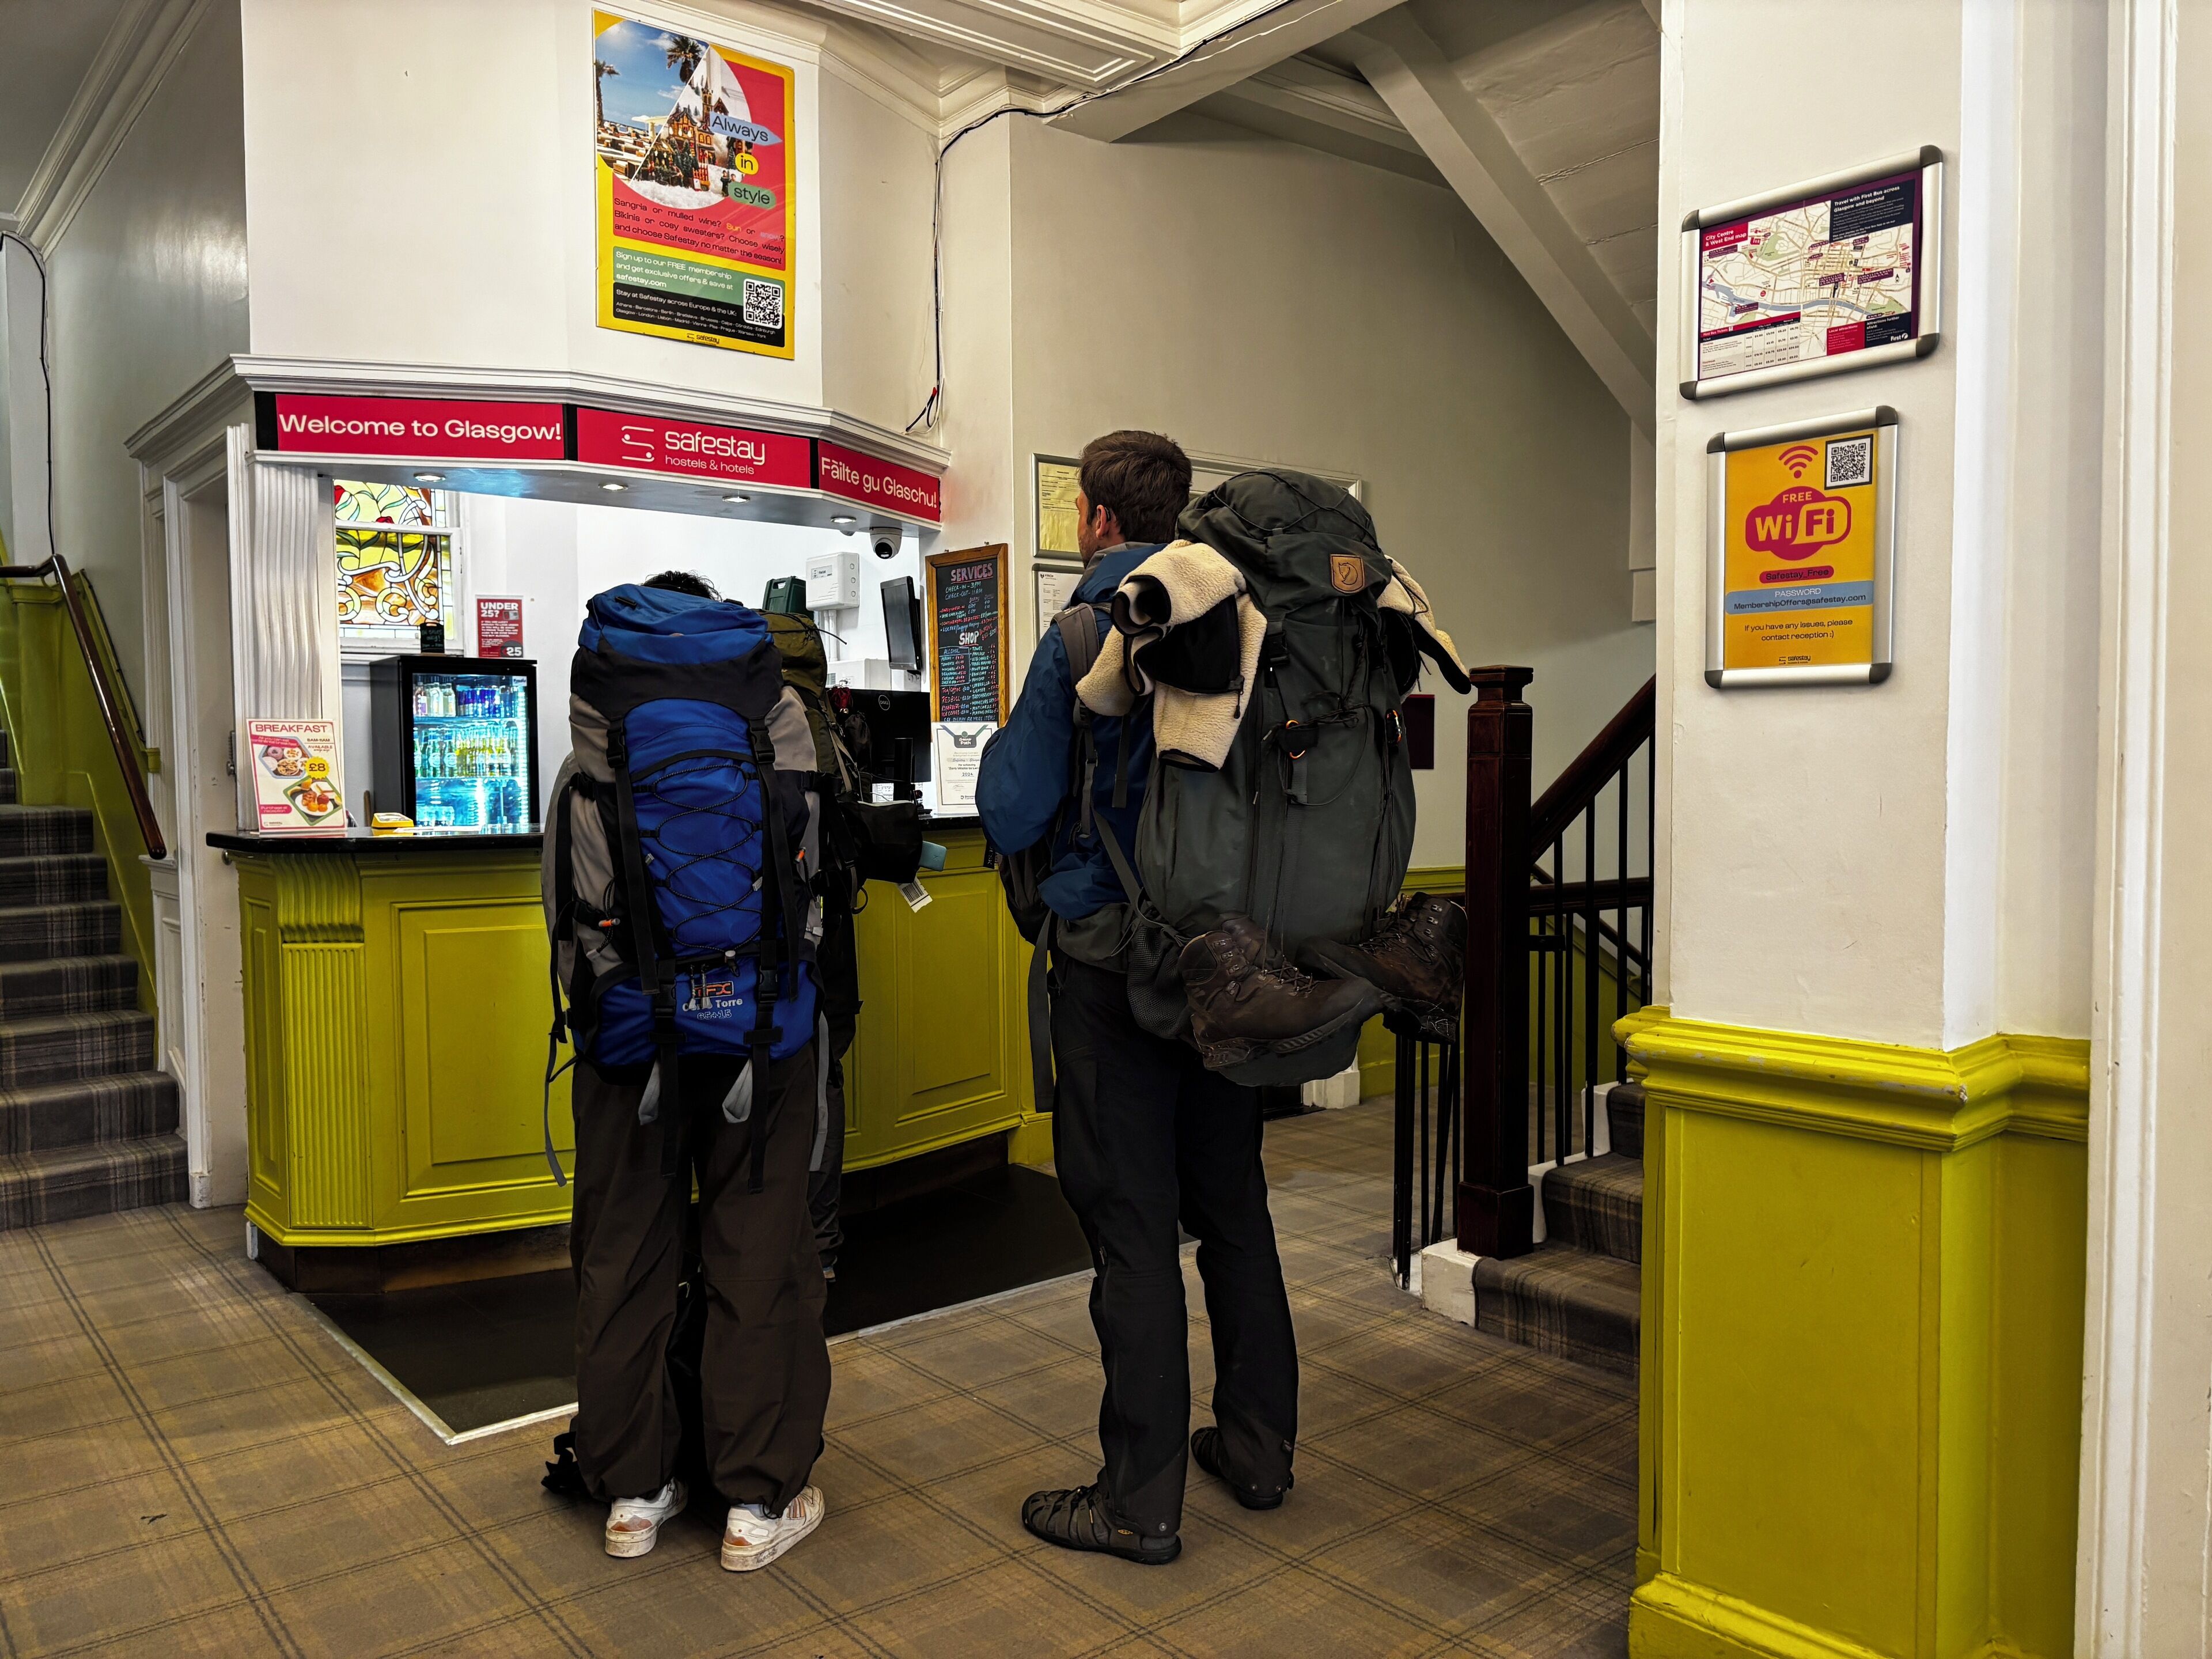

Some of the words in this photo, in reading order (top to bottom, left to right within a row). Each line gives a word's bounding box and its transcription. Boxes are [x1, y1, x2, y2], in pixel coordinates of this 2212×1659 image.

[712, 115, 768, 142] Always
[741, 156, 753, 171] in
[734, 187, 770, 204] style
[614, 198, 647, 211] Sangria
[668, 211, 694, 221] mulled
[699, 218, 721, 227] wine?
[1834, 204, 1854, 213] Glasgow
[1866, 196, 1884, 204] beyond
[615, 210, 640, 221] Bikinis
[659, 221, 679, 230] cosy
[683, 226, 725, 240] sweaters?
[729, 235, 758, 247] Choose
[762, 244, 785, 254] wisely
[615, 224, 630, 232] and
[632, 227, 662, 238] choose
[664, 233, 699, 247] Safestay
[713, 245, 738, 253] matter
[753, 254, 782, 264] season!
[616, 251, 632, 260] Sign
[668, 261, 686, 270] FREE
[688, 266, 732, 280] membership
[616, 274, 666, 287] safestay.com
[645, 268, 678, 279] exclusive
[679, 275, 702, 284] offers
[616, 289, 631, 298] Stay
[639, 293, 666, 304] Safestay
[689, 302, 711, 312] Europe
[696, 335, 719, 344] safestay
[279, 414, 405, 435] Welcome
[411, 419, 438, 437] to
[445, 419, 562, 444] Glasgow!
[665, 431, 765, 465] safestay
[665, 455, 707, 469] hostels
[710, 460, 718, 471] &
[721, 461, 755, 475] hotels
[862, 474, 880, 493] gu
[883, 476, 937, 508] Glaschu!
[1783, 491, 1812, 503] FREE
[951, 563, 993, 582] SERVICES
[1766, 568, 1829, 581] Safestay_Free
[1775, 588, 1821, 597] PASSWORD
[480, 602, 518, 610] UNDER
[1734, 594, 1866, 610] MembershipOffers@safestay.com
[959, 631, 979, 645] SHOP
[1791, 631, 1828, 640] reception
[507, 647, 522, 656] 25
[256, 724, 327, 733] BREAKFAST
[309, 763, 325, 772] £8
[715, 999, 743, 1009] Torre
[698, 1009, 732, 1020] 65+15
